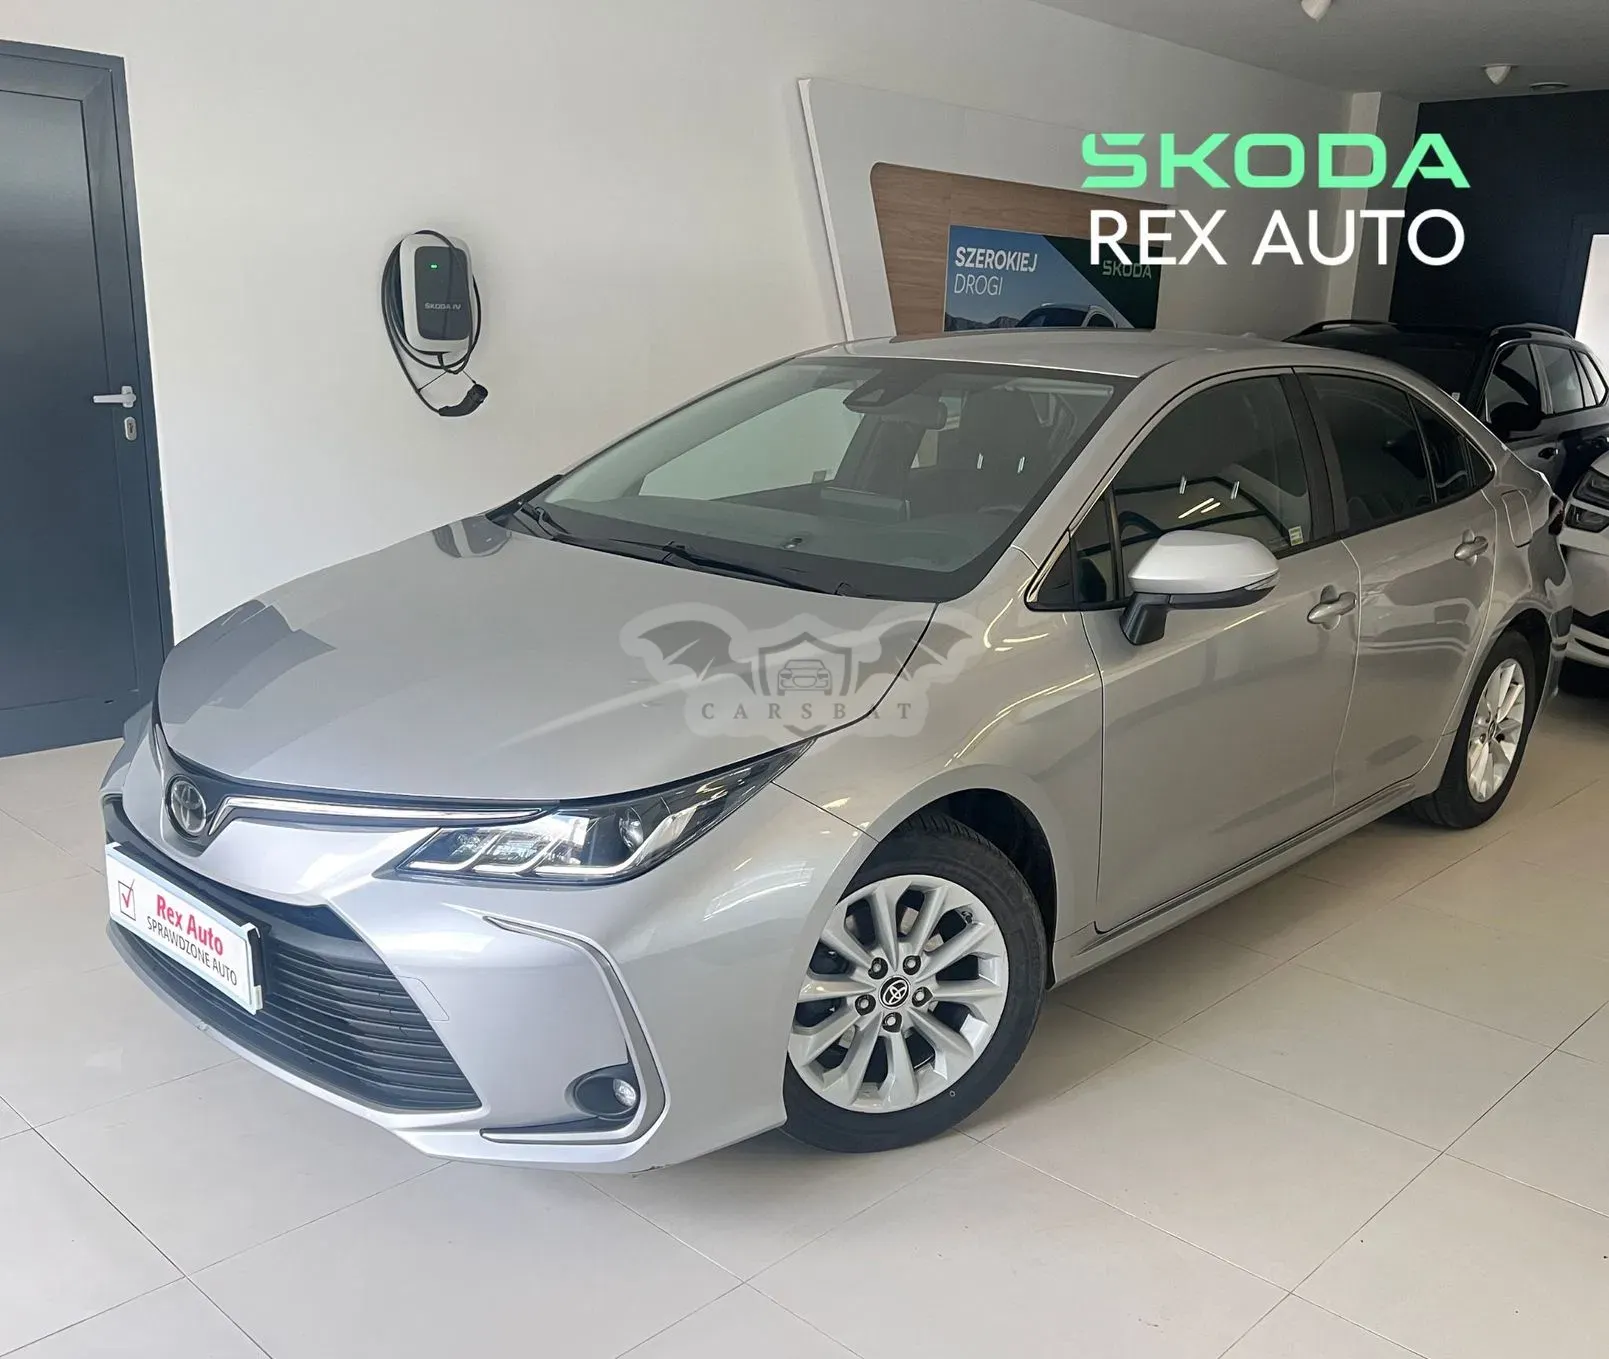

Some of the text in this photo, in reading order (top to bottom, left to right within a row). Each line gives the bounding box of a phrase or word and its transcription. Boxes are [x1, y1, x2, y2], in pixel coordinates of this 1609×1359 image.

[955, 246, 1038, 272] SZEROKIEJ
[954, 273, 1003, 296] DROGI
[156, 894, 224, 956] Rex Auto
[147, 915, 238, 986] SPRAWDZONE AUTO
